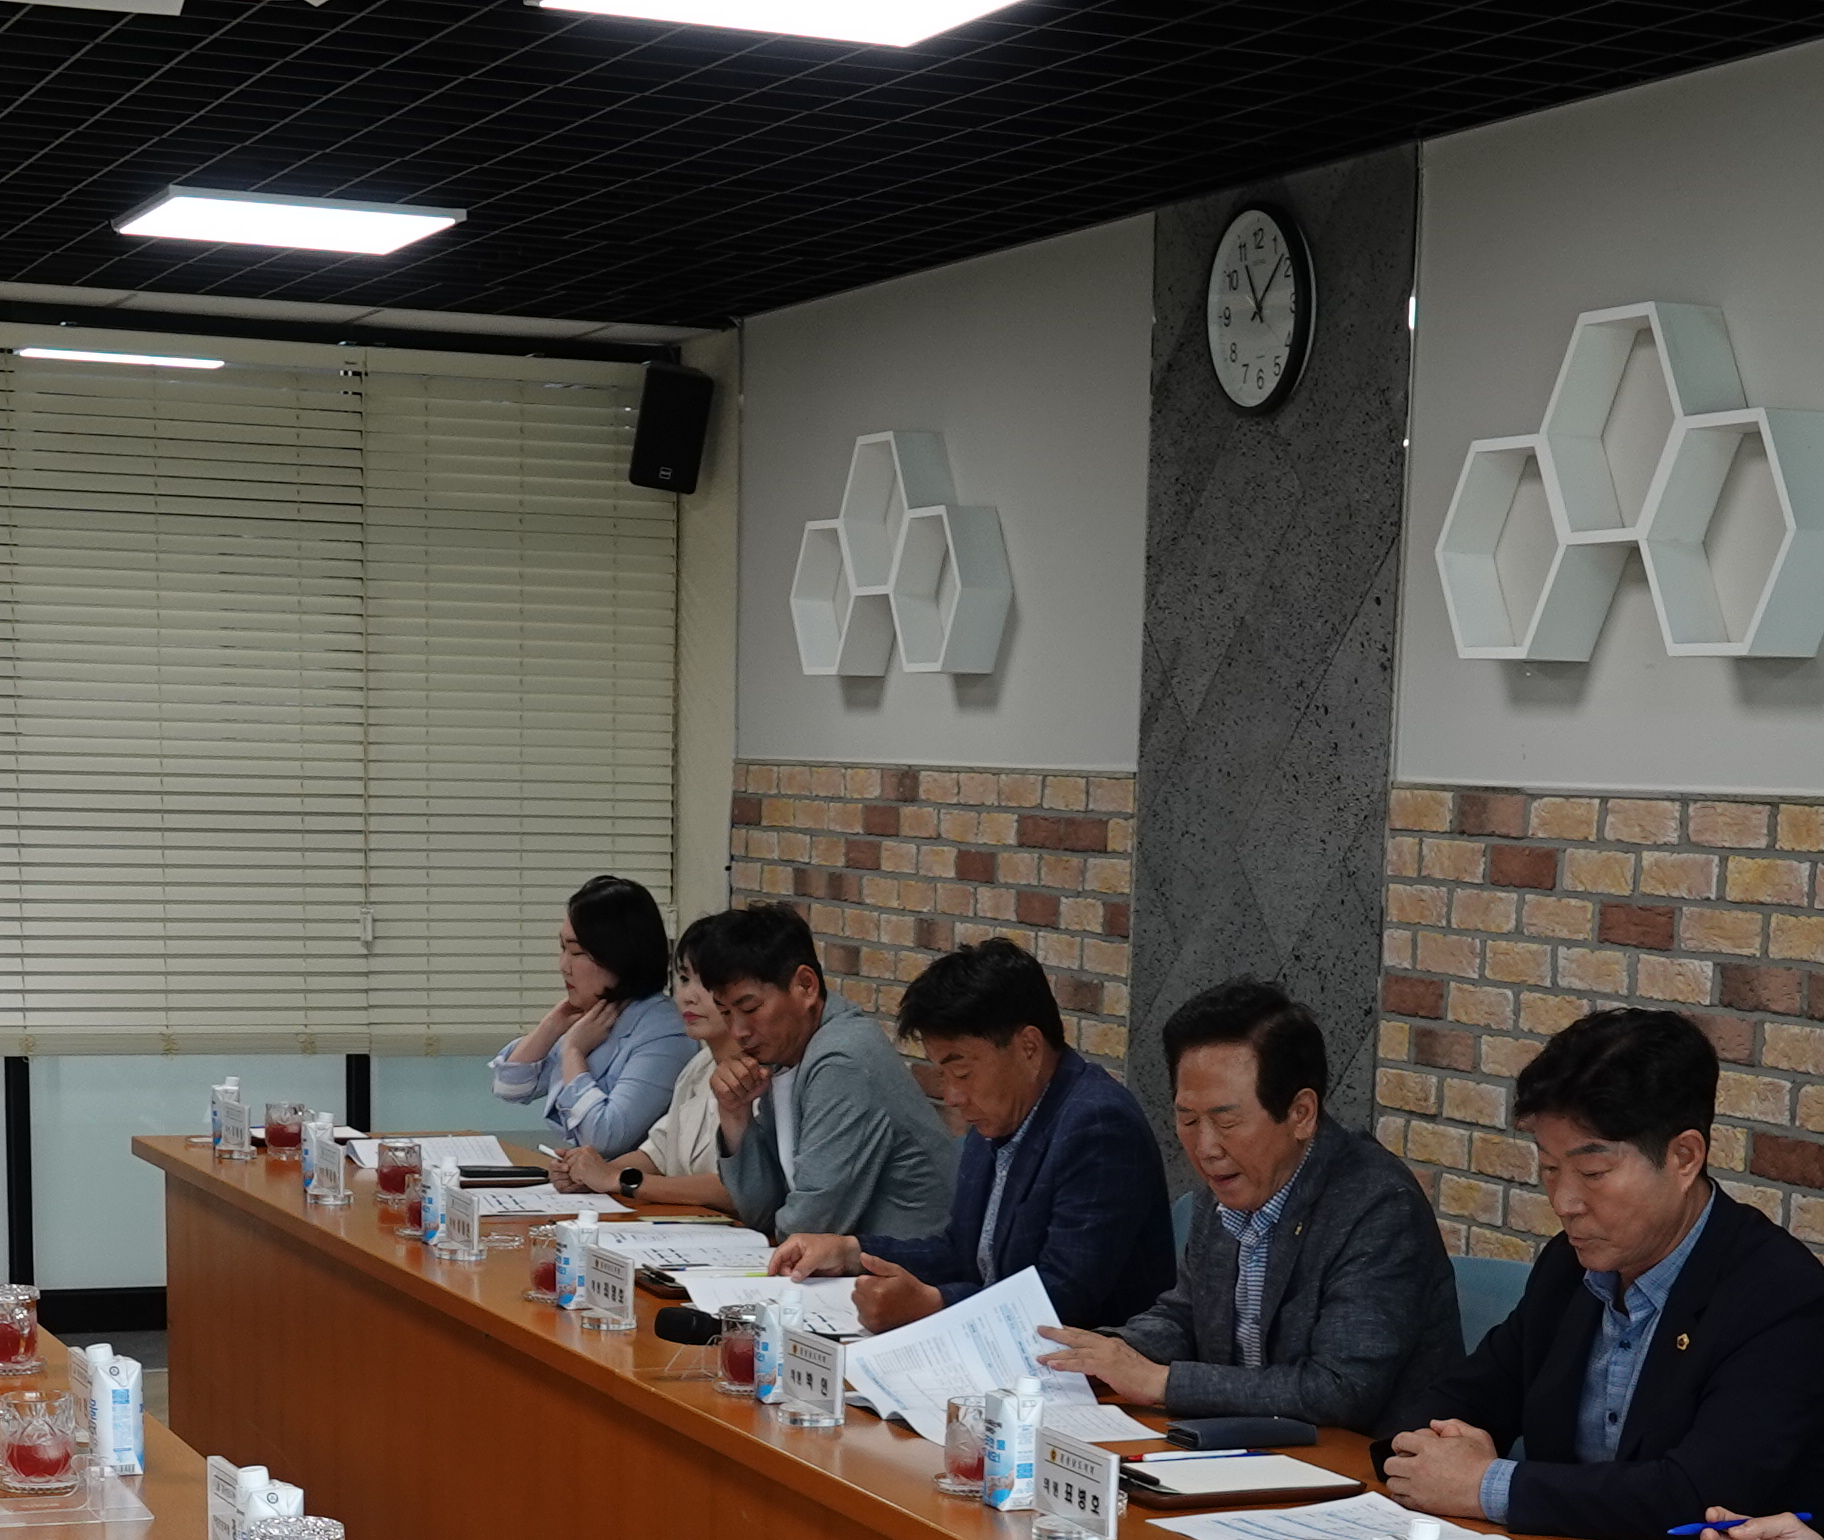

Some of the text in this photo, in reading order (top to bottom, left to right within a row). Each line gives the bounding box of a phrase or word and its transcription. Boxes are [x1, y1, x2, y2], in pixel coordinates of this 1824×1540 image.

[1253, 227, 1264, 250] 12
[1238, 242, 1248, 263] 11
[1284, 256, 1292, 279] 2
[1225, 269, 1239, 292] 10
[1223, 305, 1231, 328] 9
[1229, 342, 1238, 363] 8
[1242, 363, 1250, 384] 7
[1273, 355, 1281, 377] 5
[1256, 368, 1264, 390] 6
